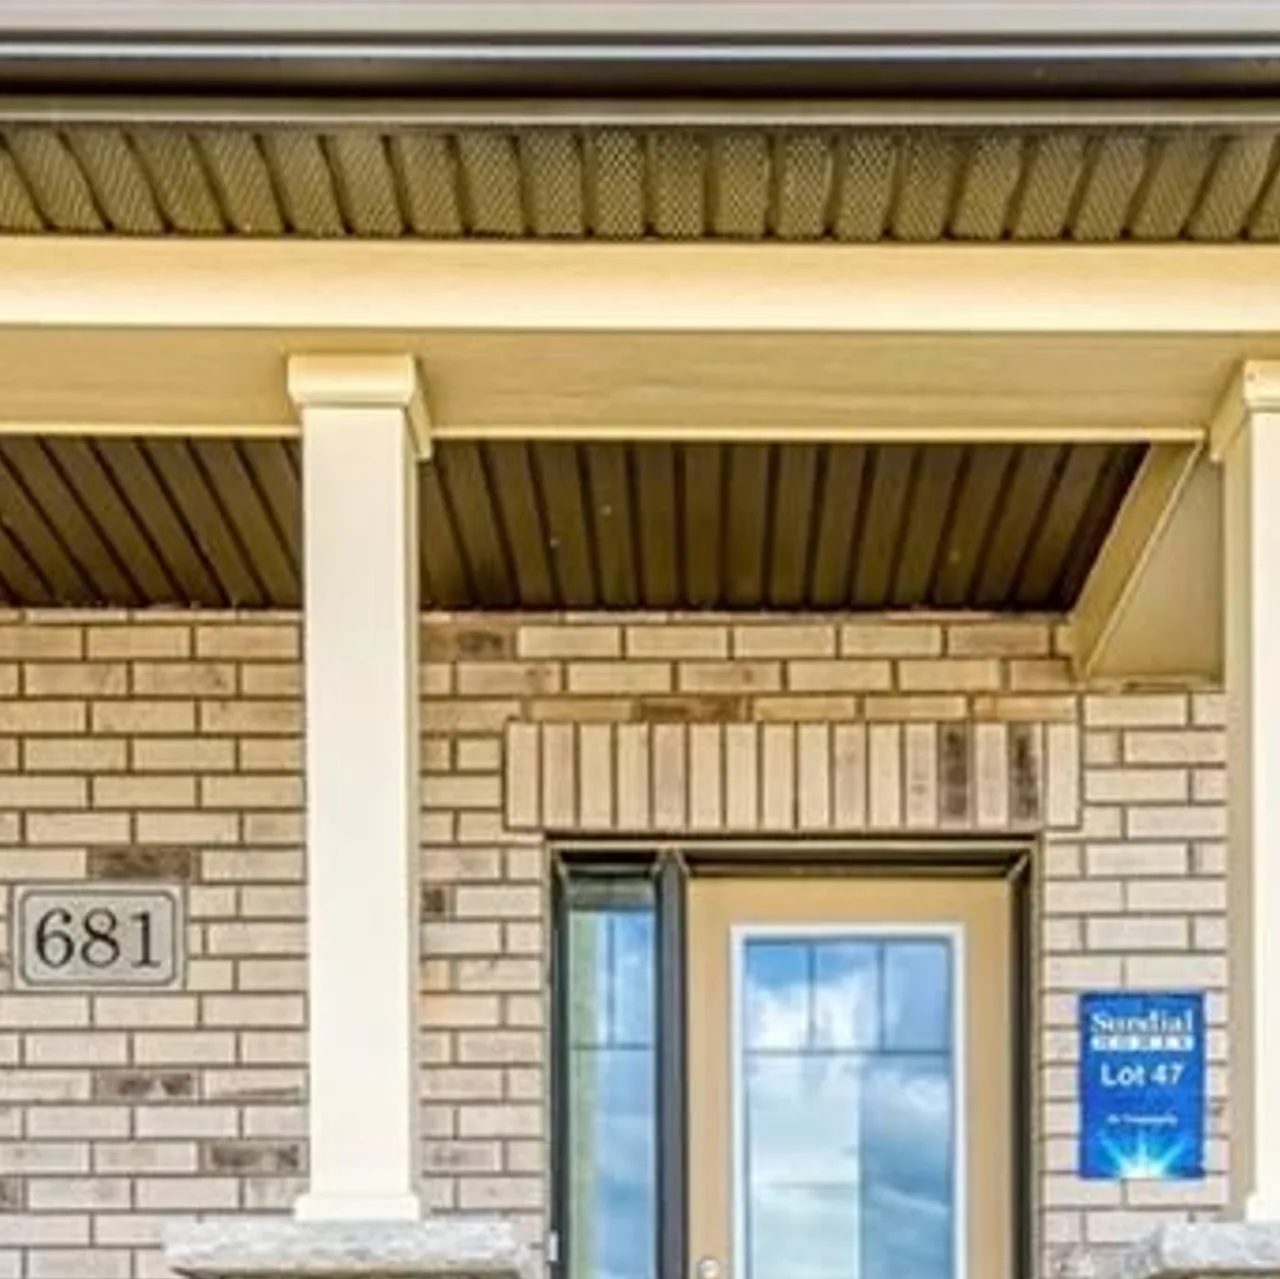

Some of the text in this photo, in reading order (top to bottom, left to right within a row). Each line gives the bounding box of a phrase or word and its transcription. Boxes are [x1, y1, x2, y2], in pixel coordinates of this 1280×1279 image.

[35, 906, 162, 970] 681
[1100, 1062, 1185, 1087] Lot 47
